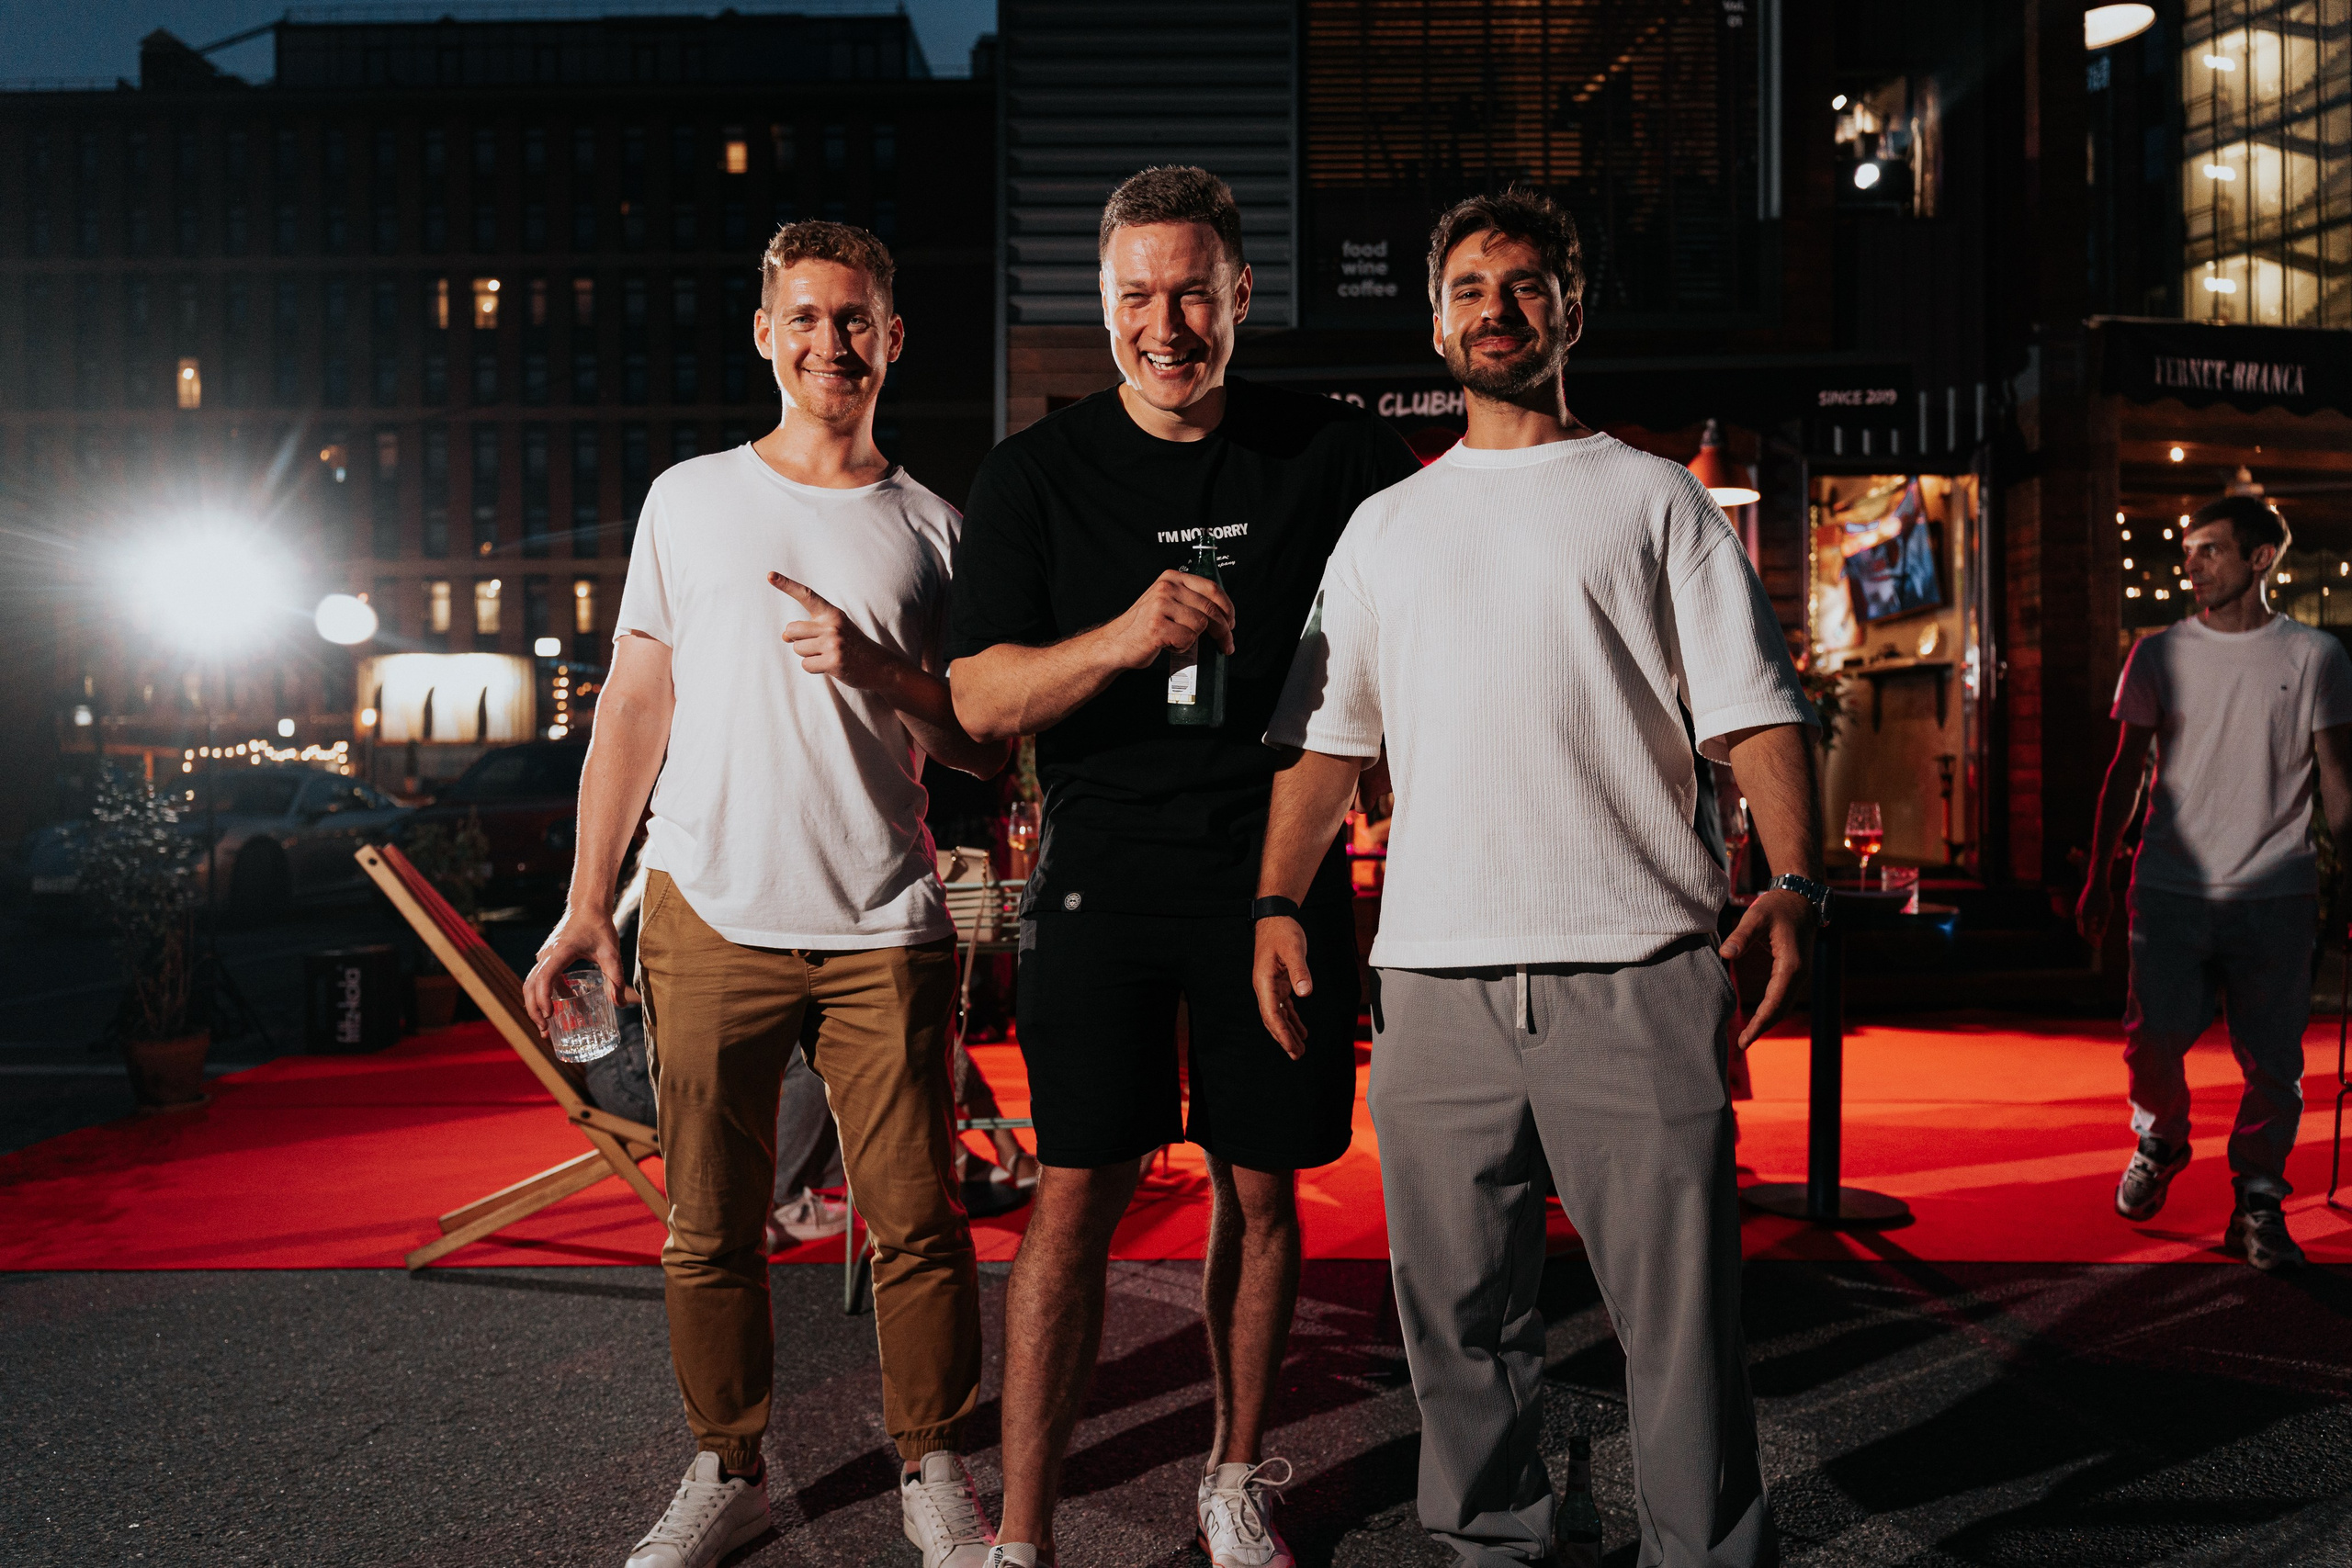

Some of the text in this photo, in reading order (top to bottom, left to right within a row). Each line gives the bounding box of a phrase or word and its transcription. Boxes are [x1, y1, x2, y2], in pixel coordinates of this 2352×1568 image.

[1341, 240, 1388, 257] food
[1341, 257, 1388, 276] wine
[1337, 279, 1398, 298] coffee
[1378, 389, 1466, 418] CLUBH
[1818, 389, 1863, 407] SINCE
[1158, 530, 1179, 543] I'M
[1206, 523, 1248, 540] SORRY
